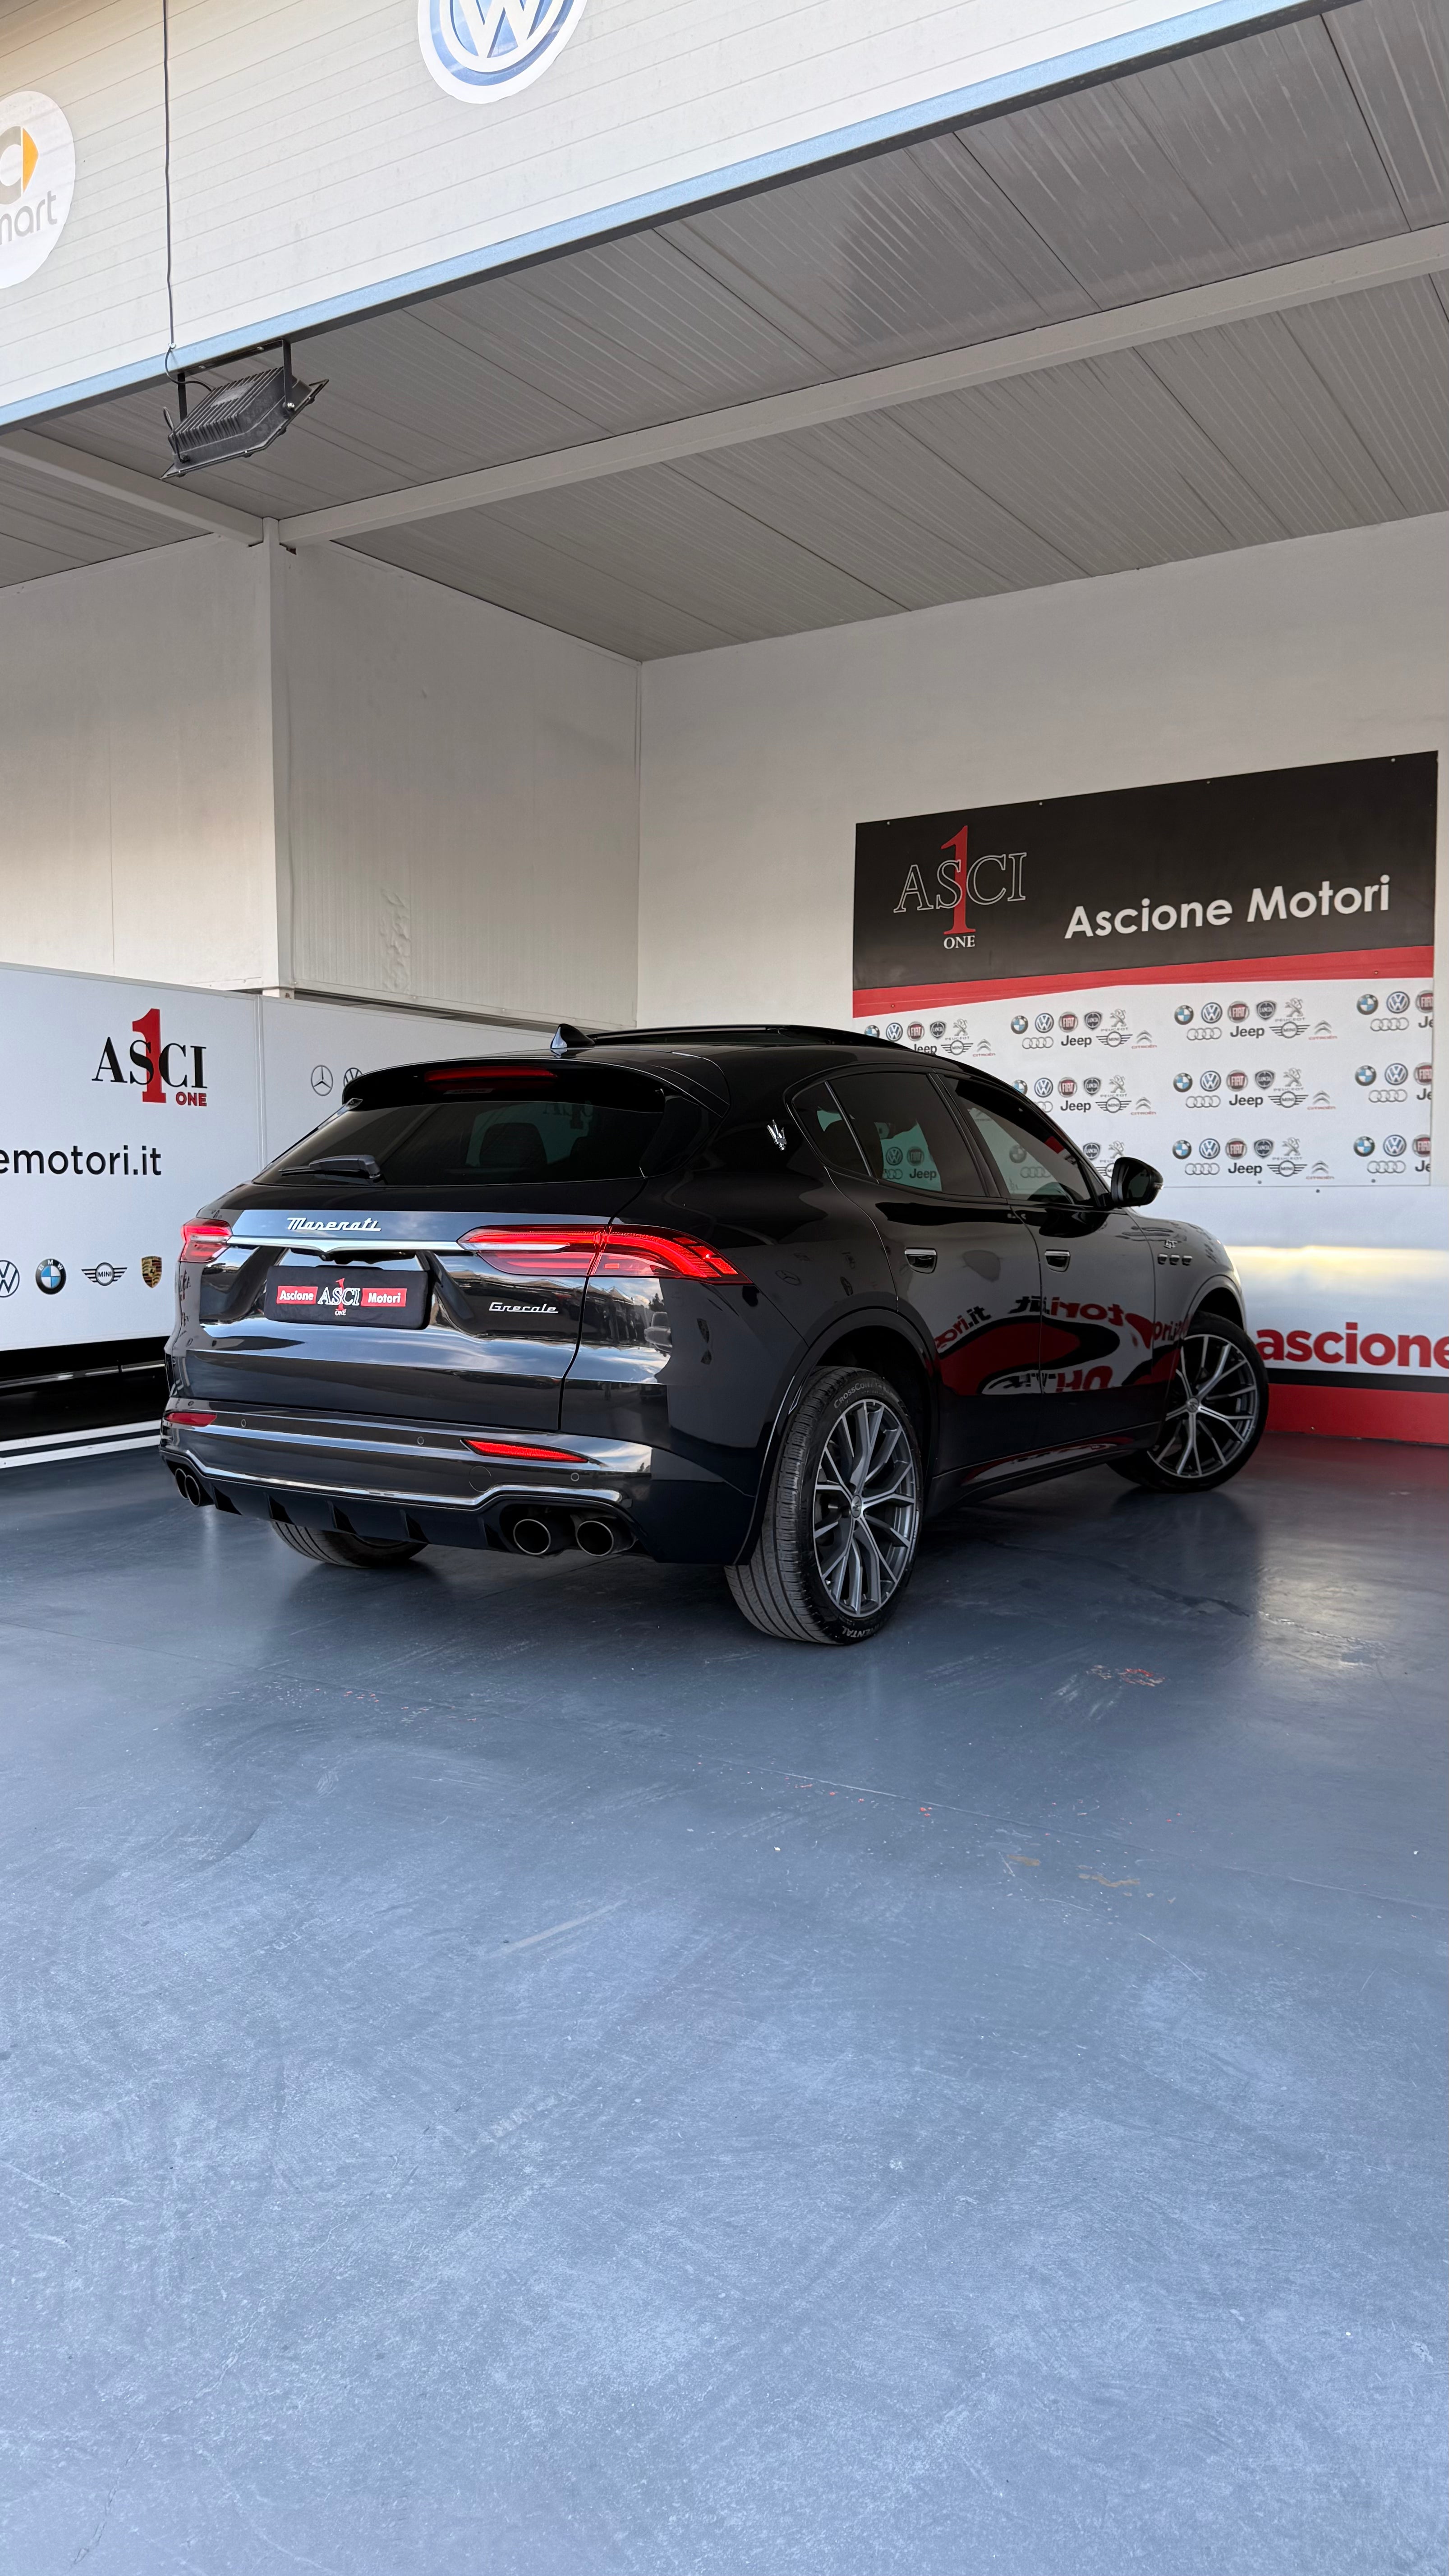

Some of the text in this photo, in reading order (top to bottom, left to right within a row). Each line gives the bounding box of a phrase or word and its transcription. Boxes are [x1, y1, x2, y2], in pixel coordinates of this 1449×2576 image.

[1065, 874, 1390, 939] Ascione Motori
[943, 935, 975, 949] ONE
[1230, 1026, 1265, 1038] Jeep
[1061, 1035, 1092, 1047] Jeep
[92, 1037, 207, 1089] ASCI
[176, 1092, 207, 1107] ONE
[1229, 1095, 1263, 1107] Jeep
[1060, 1100, 1091, 1113] Jeep
[910, 1169, 937, 1180] Jeep
[1228, 1163, 1262, 1176] Jeep
[287, 1217, 382, 1232] Maserati
[38, 1259, 63, 1271] BMW
[279, 1290, 314, 1301] Ascione
[368, 1293, 401, 1303] Motori
[489, 1302, 559, 1313] Grecale
